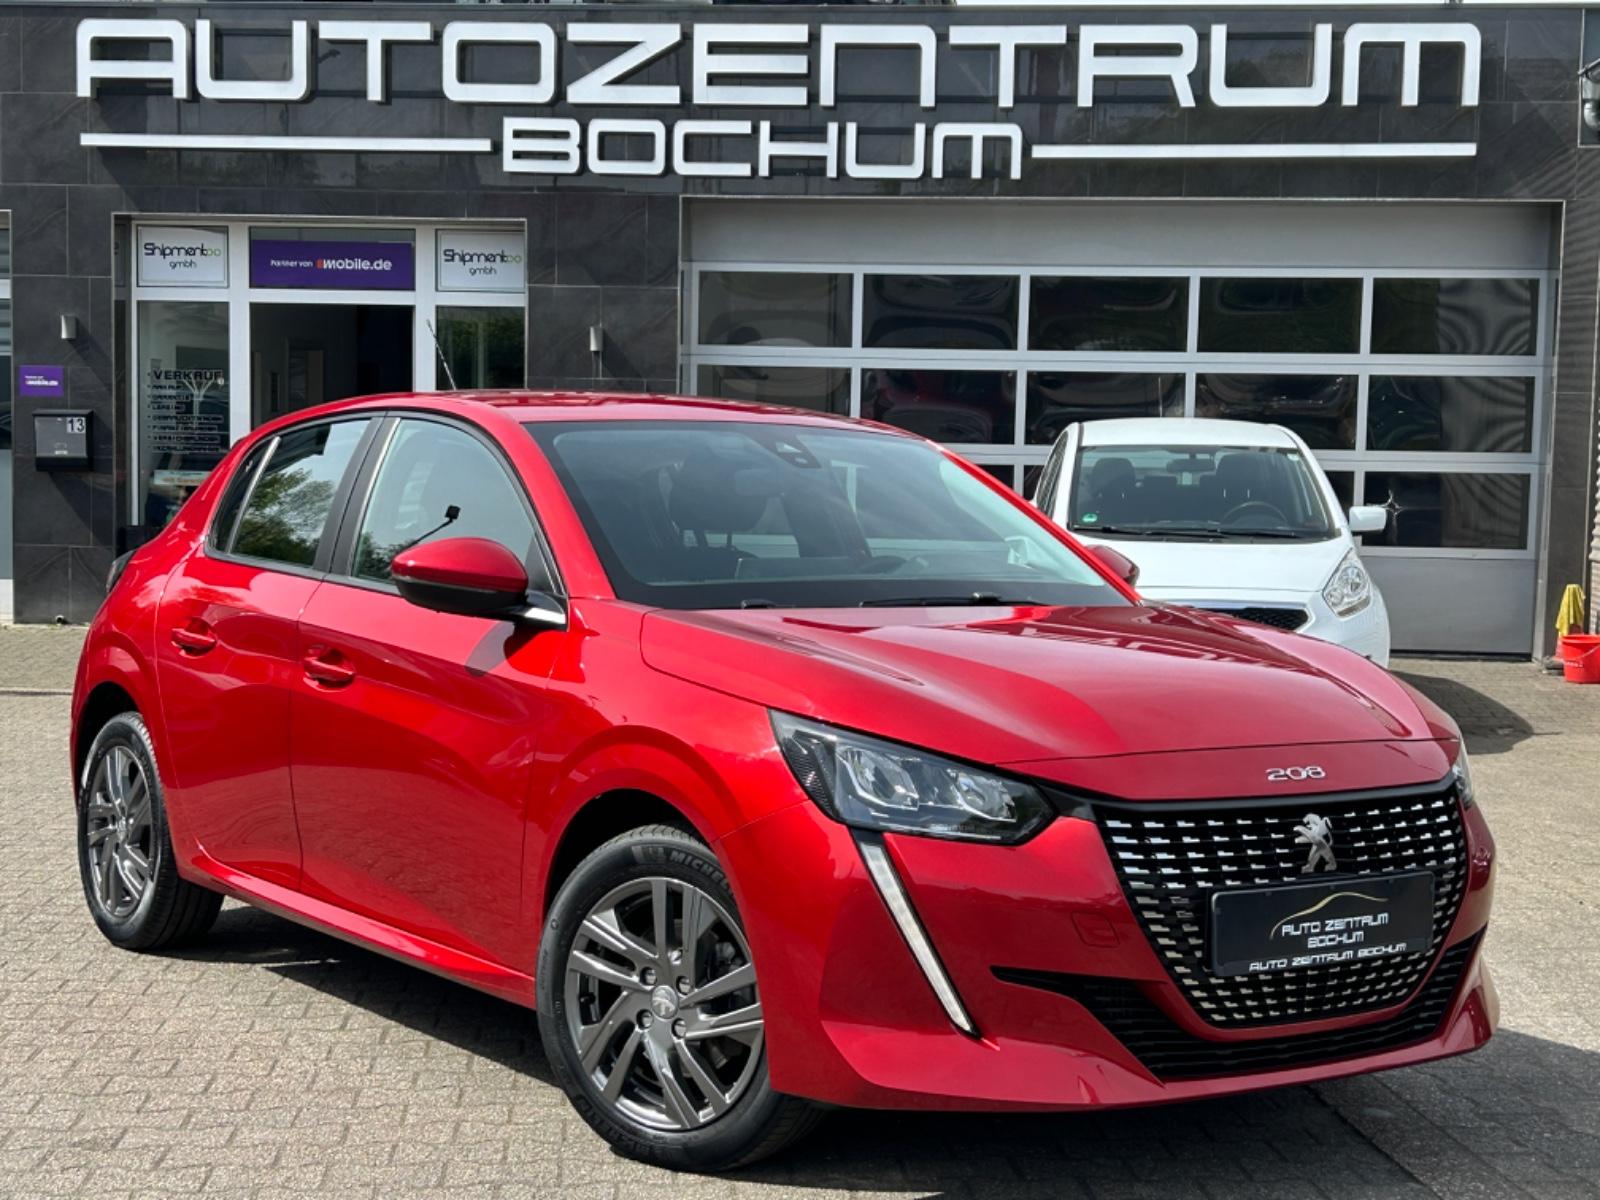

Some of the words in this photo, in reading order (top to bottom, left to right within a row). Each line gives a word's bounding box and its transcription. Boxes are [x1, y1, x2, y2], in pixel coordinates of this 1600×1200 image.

[76, 19, 1481, 108] AUTOZENTRUM
[502, 116, 1023, 181] BOCHUM
[322, 258, 393, 271] mobile.de
[68, 418, 85, 432] 13
[1265, 766, 1326, 781] 208
[669, 849, 730, 891] MICHEL
[1281, 921, 1320, 937] AUTO
[1324, 912, 1389, 932] ZENTRUM
[1307, 931, 1365, 948] BOCHUM
[1249, 958, 1288, 972] AUTO
[1291, 950, 1354, 966] ZENTRUM
[1357, 942, 1407, 958] BOCHUM
